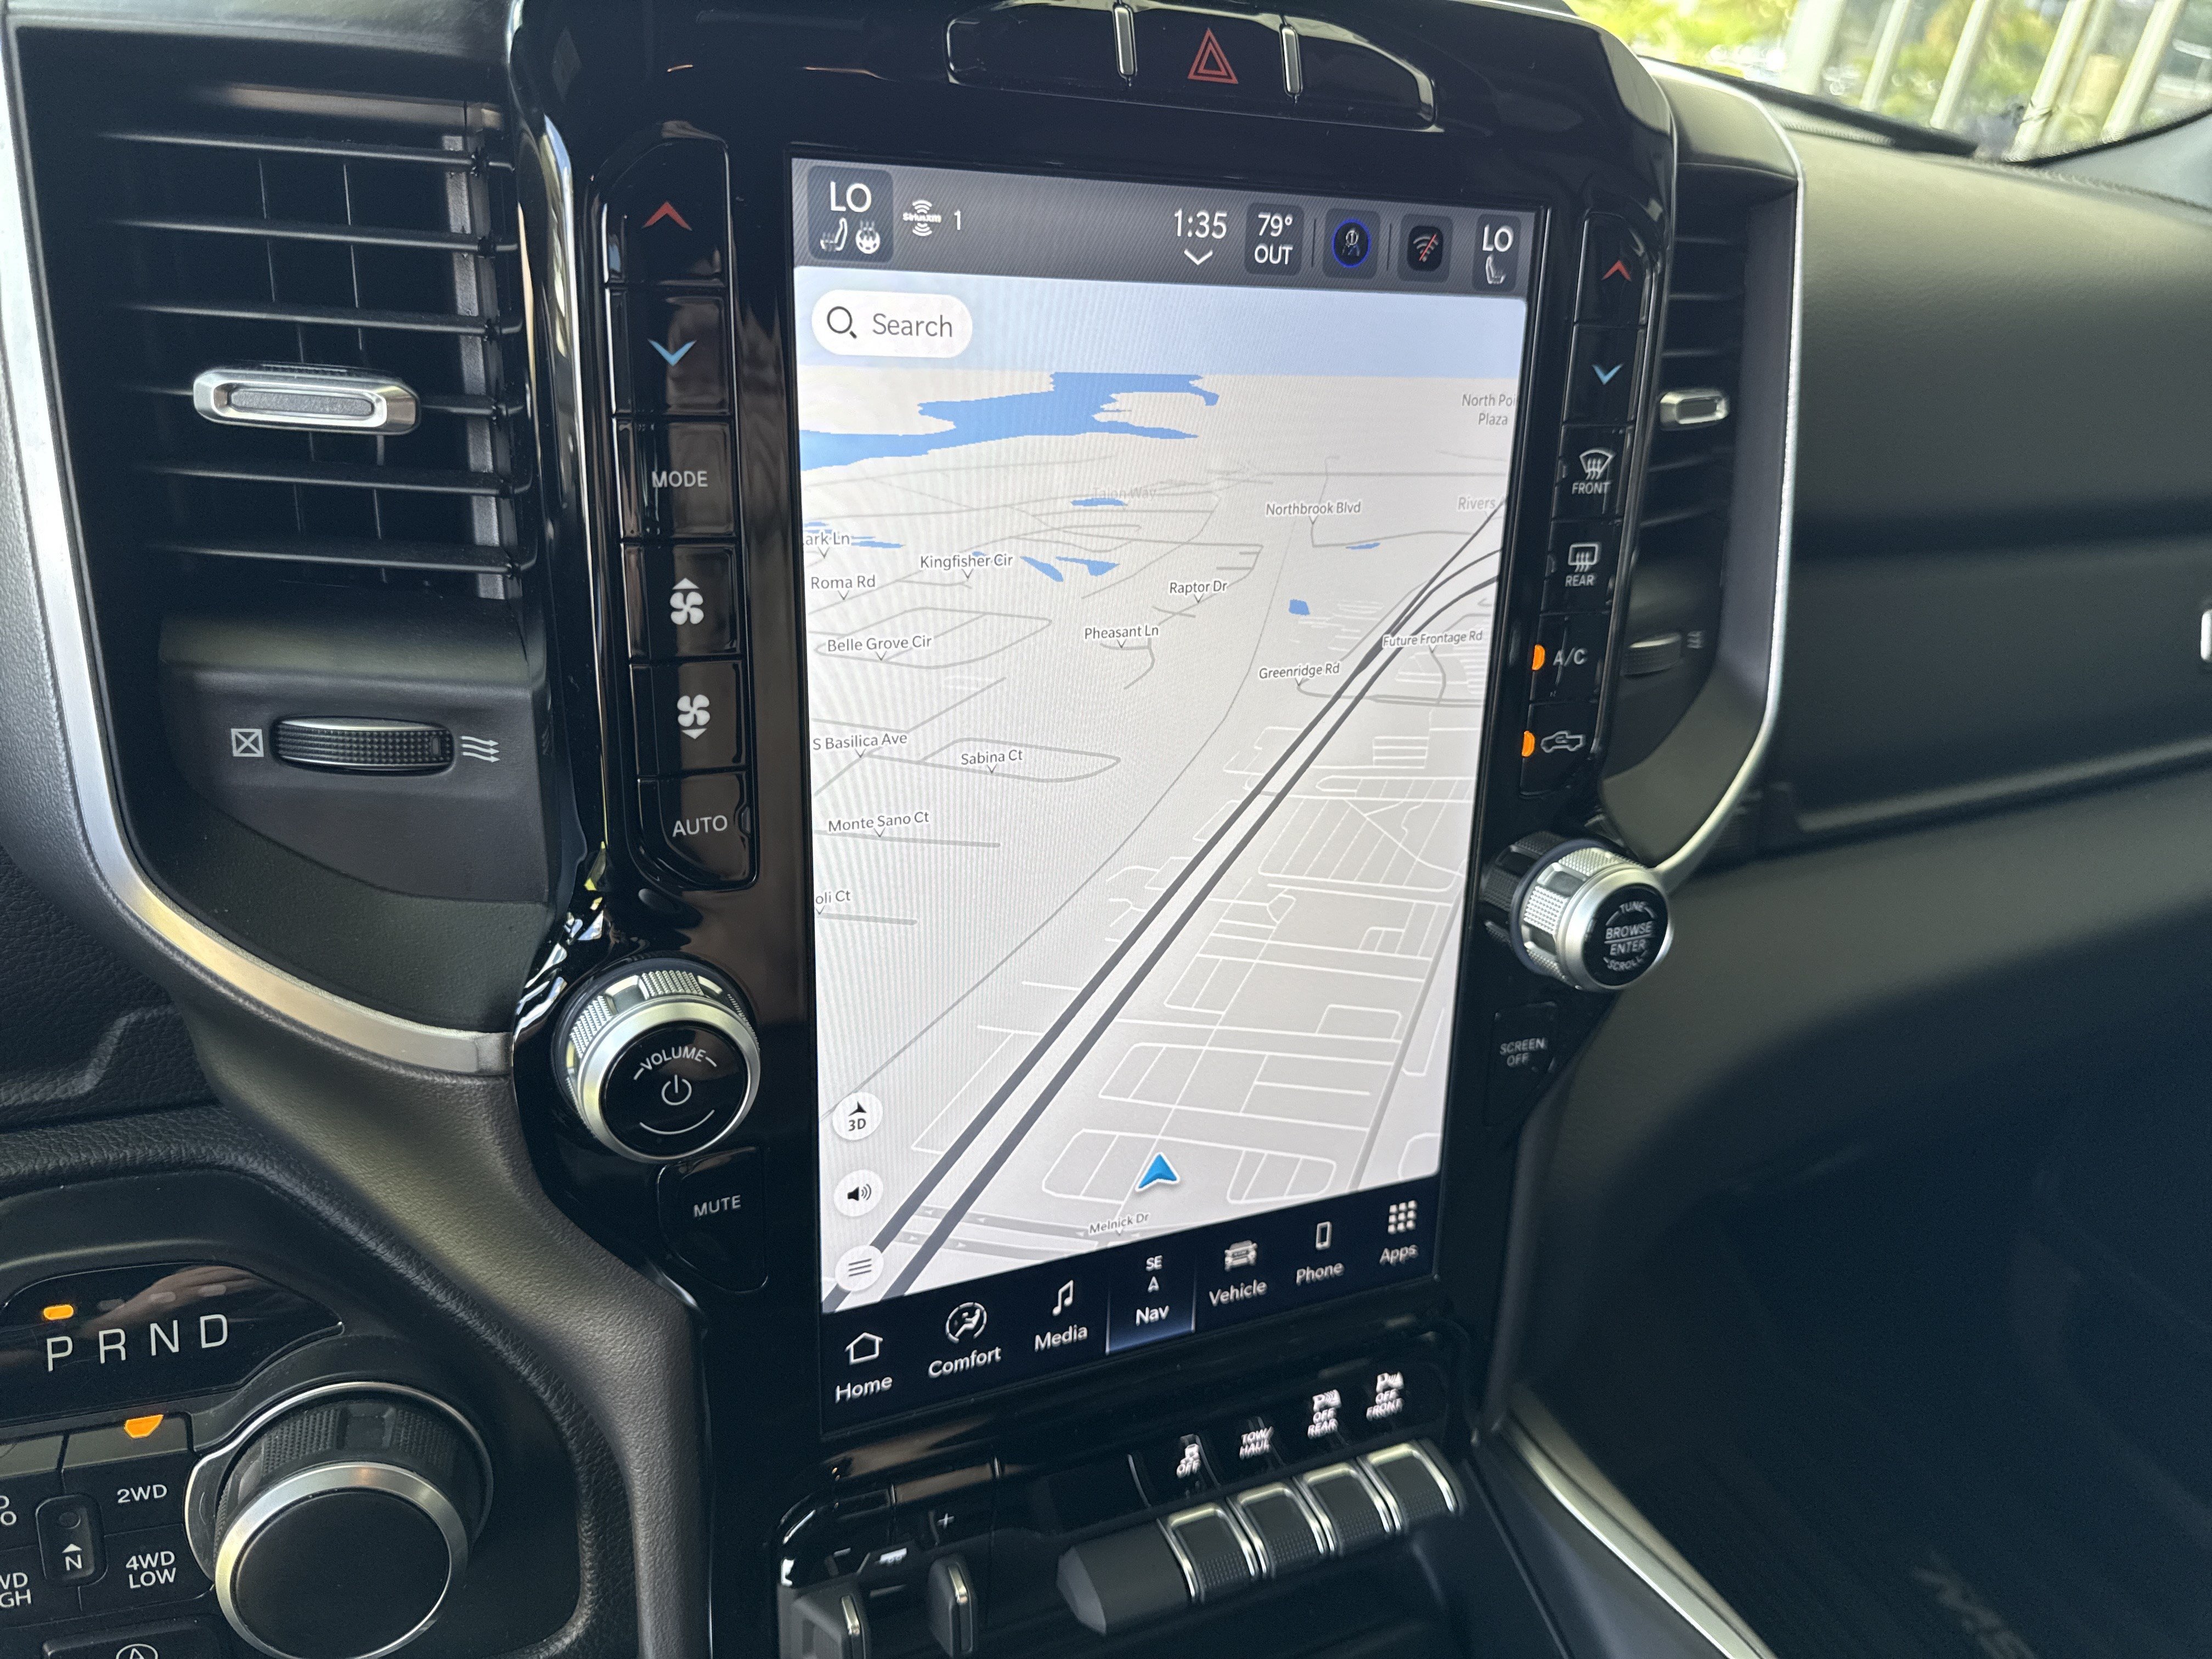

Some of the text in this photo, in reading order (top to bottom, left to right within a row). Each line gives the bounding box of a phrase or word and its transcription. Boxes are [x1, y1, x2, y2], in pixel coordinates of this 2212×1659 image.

[830, 182, 872, 212] LO
[954, 210, 961, 230] 1
[1175, 209, 1228, 239] 1:35
[1482, 225, 1514, 252] LO
[1254, 244, 1293, 265] OUT
[872, 313, 953, 338] Search
[1462, 394, 1496, 407] North
[1479, 414, 1508, 426] Plaza
[652, 470, 708, 488] MODE
[1572, 482, 1611, 494] FRONT
[1266, 502, 1361, 516] Northbrook Blvd
[1458, 496, 1496, 510] Rivers
[921, 554, 1013, 571] Kingfisher Cir
[811, 575, 876, 589] Roma Rd
[1170, 581, 1228, 595] Raptor Dr
[1565, 575, 1595, 586] REAR
[1084, 624, 1159, 640] Pheasant Ln
[1383, 631, 1482, 647] Future Frontage Rd
[828, 636, 932, 652] Belle Grove Cir
[1553, 647, 1588, 667] A/C
[1259, 663, 1340, 679] Greenridge Rd
[812, 733, 907, 750] S Basilica Ave
[961, 749, 1023, 765] Sabina Ct
[672, 815, 728, 838] AUTO
[828, 812, 929, 832] Monte Sano Ct
[836, 890, 851, 901] Ct
[1620, 901, 1645, 913] TUNE
[1605, 921, 1653, 940] BROWSE
[1610, 940, 1647, 956] ENTER
[1499, 1038, 1545, 1056] SCREEN
[640, 1047, 707, 1071] VOLUME
[1506, 1053, 1528, 1068] OFF
[848, 1118, 866, 1132] 3D
[693, 1195, 742, 1218] MUTE
[1089, 1212, 1149, 1234] Melnick Dr
[1146, 1255, 1163, 1271] SE
[1379, 1244, 1419, 1265] Apps
[1296, 1262, 1345, 1285] Phone
[1209, 1280, 1267, 1306] Vehicle
[1135, 1305, 1170, 1326] Nav
[47, 1314, 228, 1371] P R N D
[1035, 1325, 1088, 1351] Media
[928, 1346, 1001, 1378] Comfort
[835, 1376, 893, 1403] Home
[1375, 1389, 1399, 1405] OFF
[1313, 1407, 1336, 1425] OFF
[1366, 1398, 1403, 1421] FRONT
[1307, 1418, 1338, 1440] REAR
[1239, 1440, 1271, 1460] HAUL
[1176, 1459, 1201, 1478] OFF
[117, 1483, 167, 1504] 2WD
[65, 1555, 82, 1570] N
[126, 1550, 176, 1571] 4WD
[129, 1567, 176, 1589] LOW
